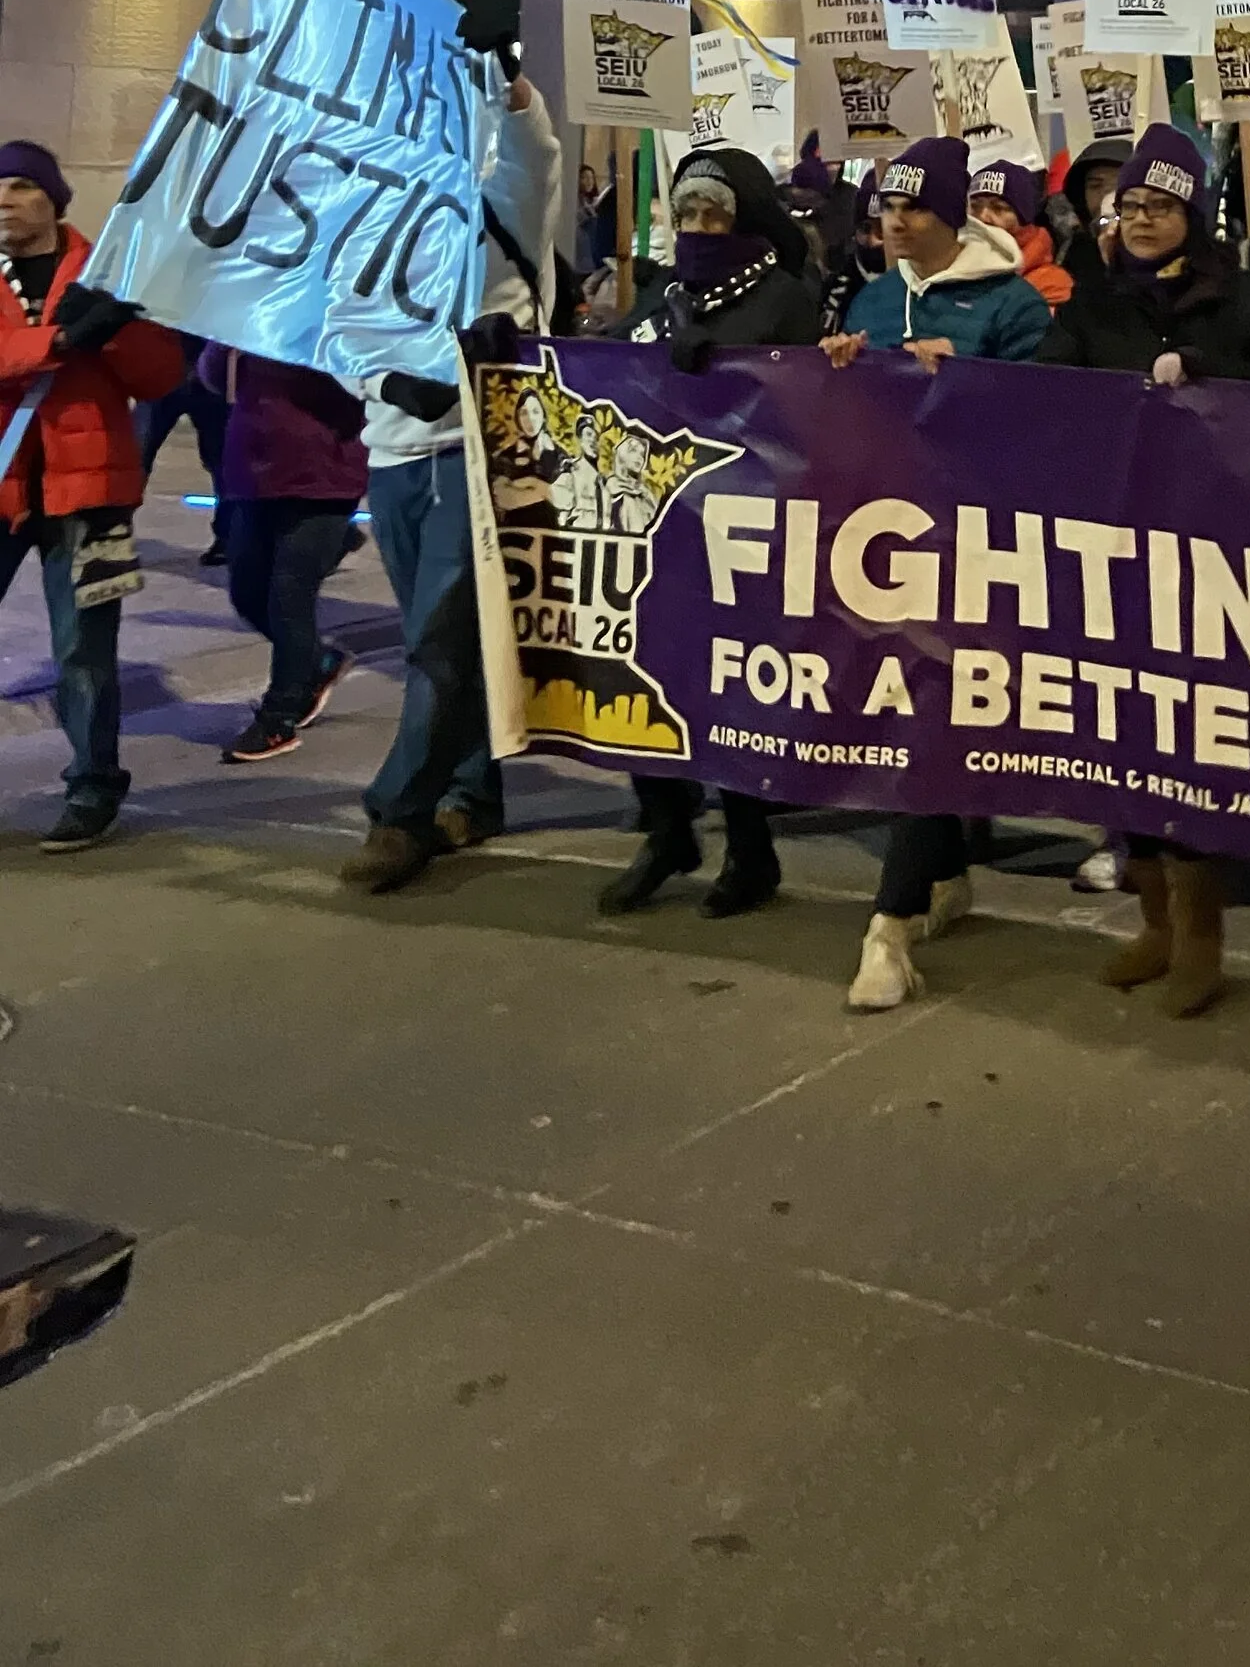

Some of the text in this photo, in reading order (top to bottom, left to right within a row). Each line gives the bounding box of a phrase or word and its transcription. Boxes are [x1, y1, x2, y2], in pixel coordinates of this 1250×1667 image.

[1152, 0, 1165, 9] 26
[847, 11, 878, 24] FOR A
[696, 38, 722, 52] TODAY
[595, 57, 647, 77] SEIU
[598, 76, 627, 87] LOCAL
[842, 95, 890, 112] SEIU
[1089, 101, 1131, 121] SEIU
[895, 178, 919, 193] ALL
[502, 532, 649, 613] SEIU
[511, 604, 634, 654] OCAL 26
[710, 637, 832, 713] FOR
[863, 656, 915, 716] A
[709, 724, 909, 767] AIRPORT WORKERS
[966, 750, 1119, 787] COMMERCIAL
[1126, 770, 1143, 789] &
[1147, 774, 1220, 812] RETAIL
